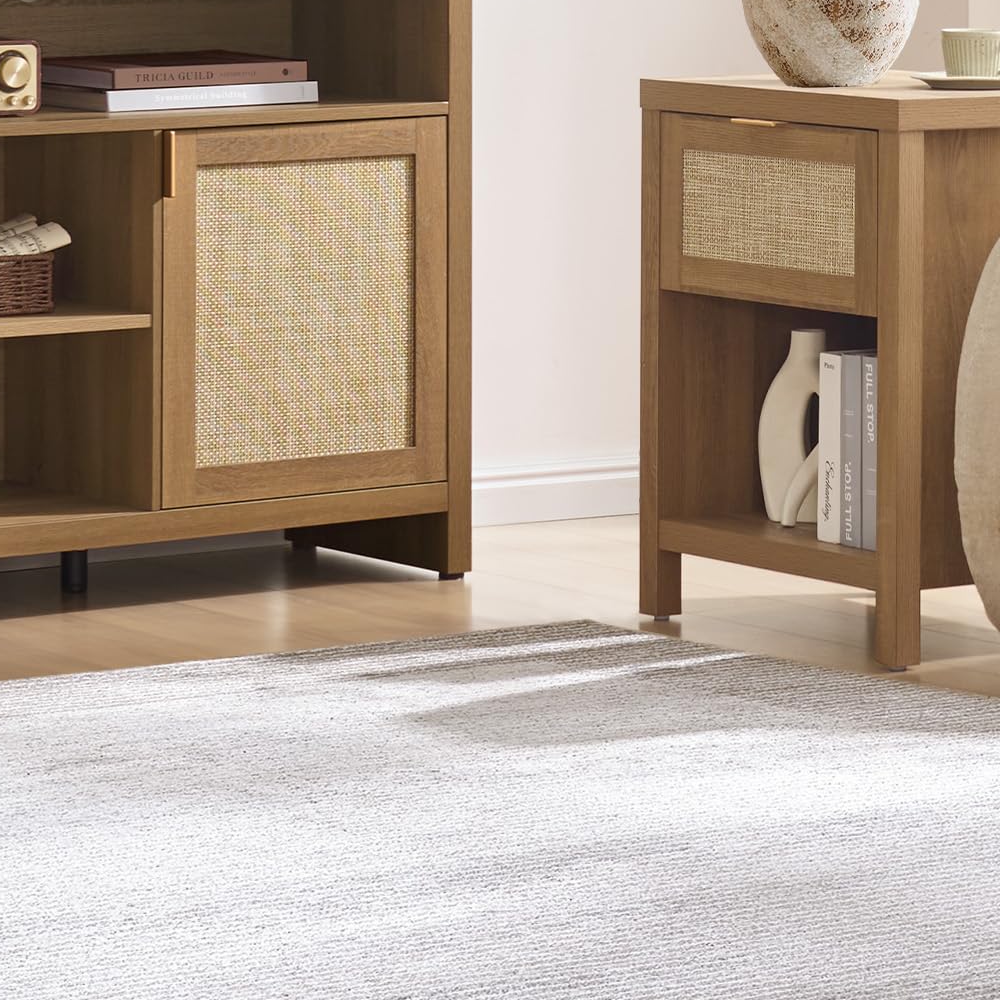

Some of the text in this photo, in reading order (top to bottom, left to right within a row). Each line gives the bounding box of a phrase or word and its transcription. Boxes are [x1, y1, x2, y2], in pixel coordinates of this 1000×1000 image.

[135, 72, 175, 83] TRICIA
[177, 71, 214, 81] GUILD
[865, 362, 875, 444] FULL STOP.
[844, 461, 853, 541] FULL STOP.
